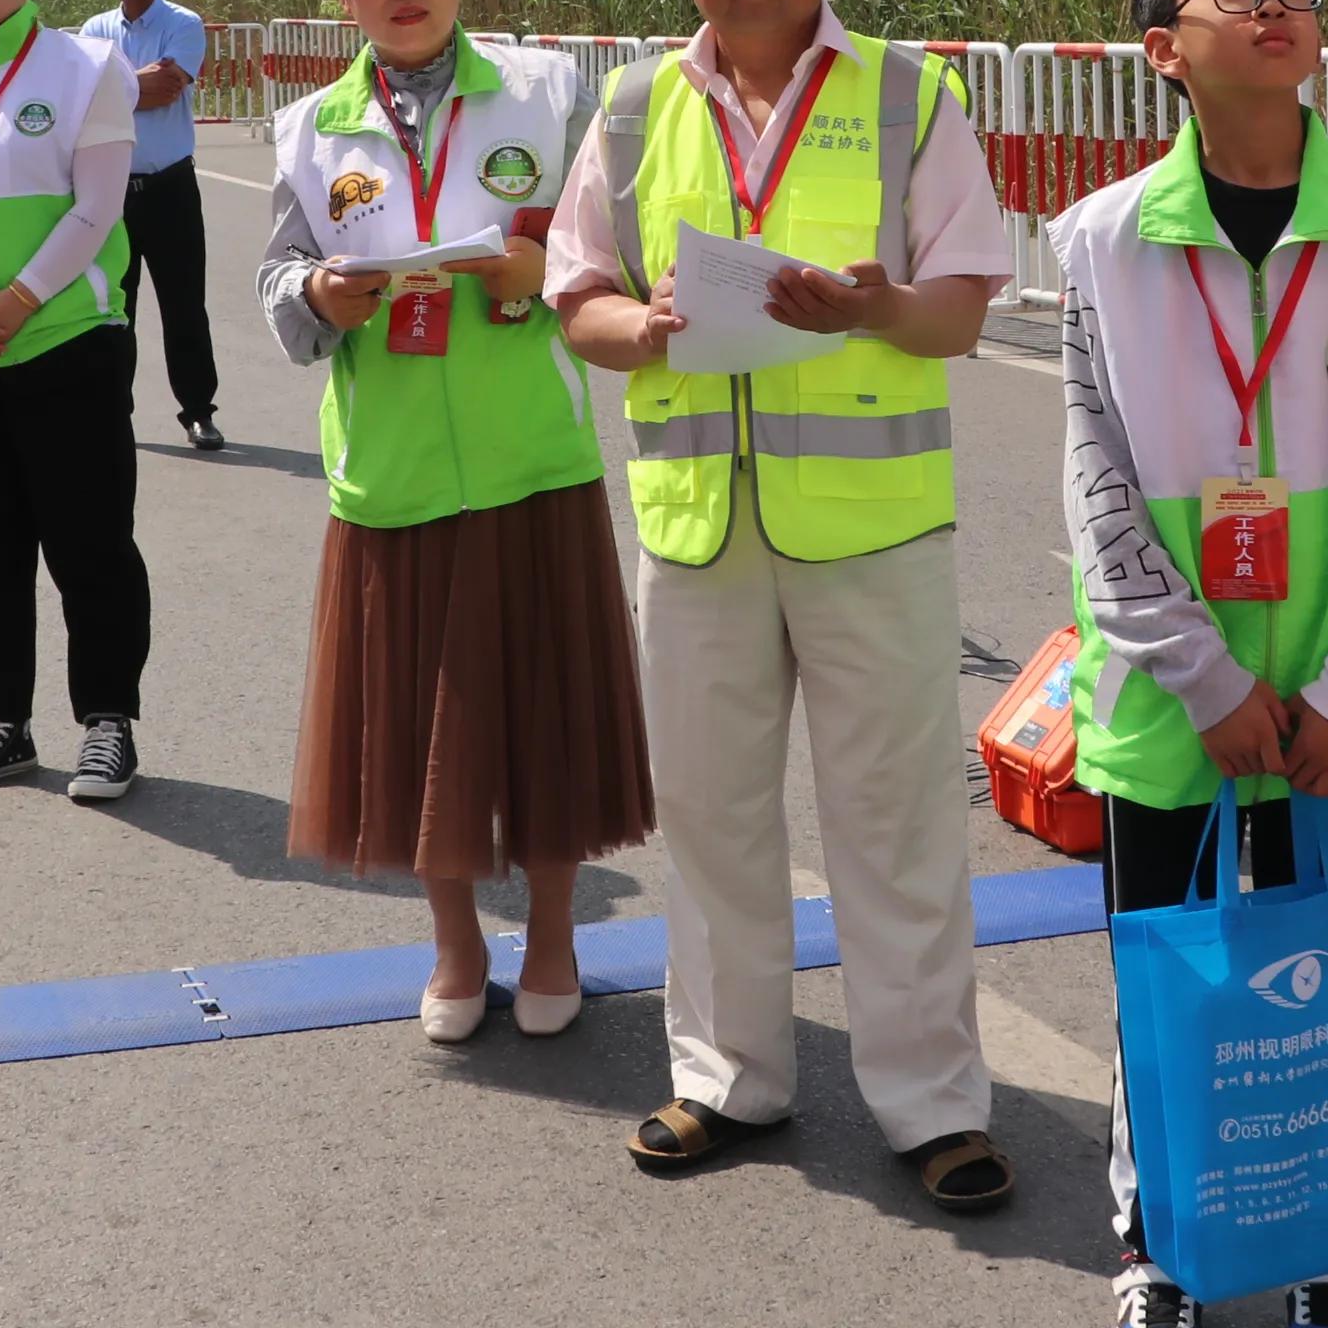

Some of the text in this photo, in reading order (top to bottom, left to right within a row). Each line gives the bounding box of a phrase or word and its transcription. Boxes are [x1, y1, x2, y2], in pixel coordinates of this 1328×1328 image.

[813, 114, 866, 132] 顺风车
[800, 132, 872, 152] 公益协会
[412, 293, 428, 337] 工作人员
[1234, 517, 1255, 577] 工作人员
